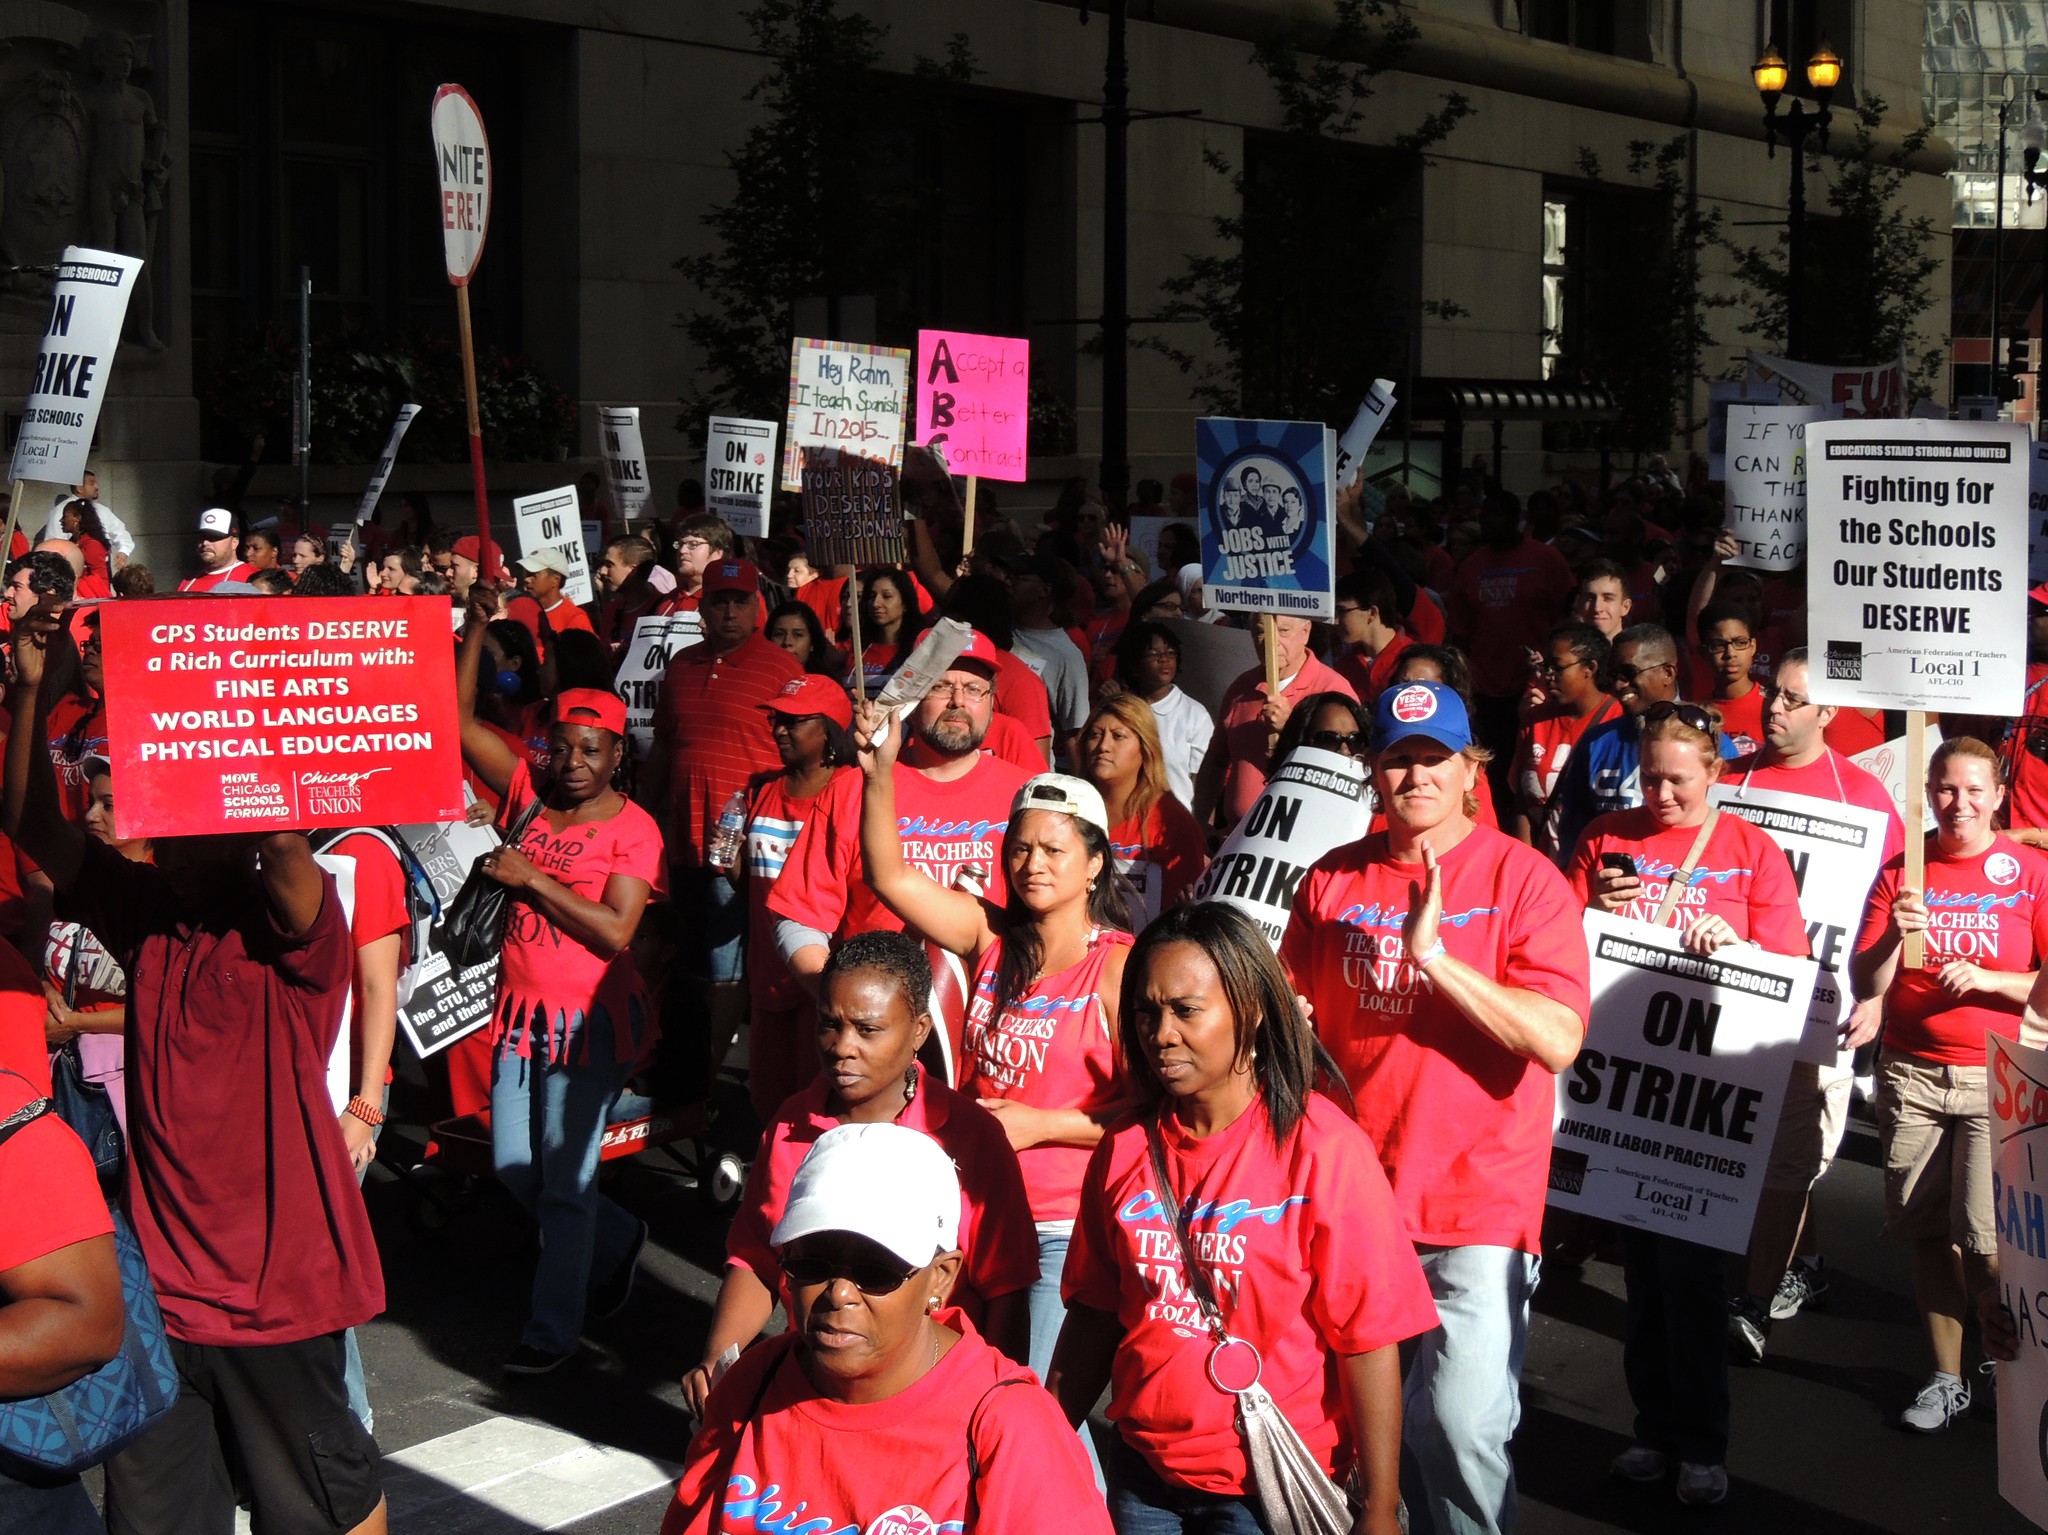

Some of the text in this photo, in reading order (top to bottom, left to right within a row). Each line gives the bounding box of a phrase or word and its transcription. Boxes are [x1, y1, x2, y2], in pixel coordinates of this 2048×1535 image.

[443, 191, 482, 233] ERE!
[58, 267, 119, 283] BLIC SCHOOLS
[818, 355, 894, 387] Hey Rahm,
[928, 338, 1025, 386] Accept a
[32, 352, 97, 399] RIKE
[797, 384, 810, 406] I
[813, 387, 851, 410] teach
[930, 390, 1015, 429] Better
[37, 410, 84, 428] SCHOOLS
[810, 412, 836, 437] In
[1743, 422, 1804, 440] IF YO
[22, 442, 59, 458] Local 1
[58, 437, 78, 445] Teachers
[725, 441, 747, 463] ON
[1829, 445, 2007, 459] EDUCATORS STAND STRONG AND UNITED
[611, 460, 642, 481] RIKE
[1734, 455, 1780, 473] CAN
[621, 486, 644, 494] ONTRACT
[710, 468, 764, 494] STRIKE
[805, 470, 893, 490] YOUR KIDS
[1763, 481, 1806, 497] THI
[1842, 475, 1949, 506] Fighting
[1957, 477, 1995, 504] for
[816, 494, 891, 515] DESERVE
[1732, 505, 1804, 523] THANK
[542, 515, 562, 539] ON
[1219, 525, 1290, 554] JOBS WITH
[1770, 528, 1781, 539] A
[1840, 518, 1996, 548] the Schools
[1735, 541, 1800, 560] TEAC
[1223, 550, 1296, 581] JUSTICE
[1833, 559, 2003, 592] Our Students
[1215, 589, 1319, 610] Northern Illinois
[1862, 603, 1971, 634] DESERVE
[152, 620, 409, 644] CPS Students DESERVE
[148, 648, 415, 671] a Rich Curriculum with:
[644, 642, 674, 670] ON
[1827, 659, 1862, 668] TEACHERS
[1887, 647, 1922, 655] American
[1923, 649, 1963, 657] Federation
[1975, 651, 2007, 659] Teachers
[1827, 667, 1861, 678] UNION
[1910, 657, 1980, 676] Local 1
[216, 677, 349, 699] FINE ARTS
[1928, 678, 1963, 686] AFL-CIO
[620, 680, 659, 710] STR
[1400, 695, 1415, 704] YES
[152, 704, 418, 731] WORLD LANGUAGES
[141, 731, 432, 762] PHYSICAL EDUCATION
[221, 773, 258, 784] MOVE
[301, 767, 392, 786] Chicago
[1280, 766, 1359, 796] BLIC SCHOOLS
[223, 784, 280, 795] CHICAGO
[224, 795, 284, 807] SCHOOLS
[308, 785, 361, 798] TEACHERS
[225, 807, 289, 818] FORWARD
[309, 798, 362, 814] UNION
[1244, 795, 1303, 842] ON
[1765, 812, 1806, 832] PUBLIC
[1808, 820, 1864, 844] SCHOOLS
[517, 827, 584, 857] TAND
[901, 841, 994, 861] TEACHERS
[541, 852, 574, 873] THE
[1784, 848, 1810, 899] N
[1197, 852, 1307, 911] STRIK
[1924, 887, 2035, 913] hicago
[1927, 912, 1999, 930] ACHERS
[1923, 929, 1999, 958] NION
[432, 981, 456, 998] IEA
[459, 955, 499, 984] suppor
[1343, 957, 1434, 996] UNION
[1601, 939, 1666, 968] CHICAGO
[1668, 954, 1719, 981] PUBLIC
[1720, 967, 1787, 997] SCHOOLS
[413, 1010, 437, 1027] the
[437, 993, 468, 1014] CTU,
[469, 981, 487, 999] its
[1359, 993, 1414, 1014] LOCAL 1
[432, 1017, 456, 1036] and
[458, 998, 487, 1023] their
[970, 995, 1057, 1040] TECHERS
[1643, 990, 1722, 1057] ON
[965, 1020, 1049, 1074] UNION
[978, 1057, 1026, 1088] LOCAL 1
[1567, 1048, 1764, 1145] STRIKE
[1559, 1118, 1746, 1179] UNFAIR LABOR PRACTICES
[1549, 1178, 1580, 1192] NION
[1614, 1165, 1739, 1203] American Federation of Teachers
[1634, 1181, 1708, 1216] Local 1
[1650, 1207, 1688, 1222] AFL-CIO
[1136, 1229, 1247, 1264] TEAHERS
[1149, 1305, 1211, 1332] LOCA
